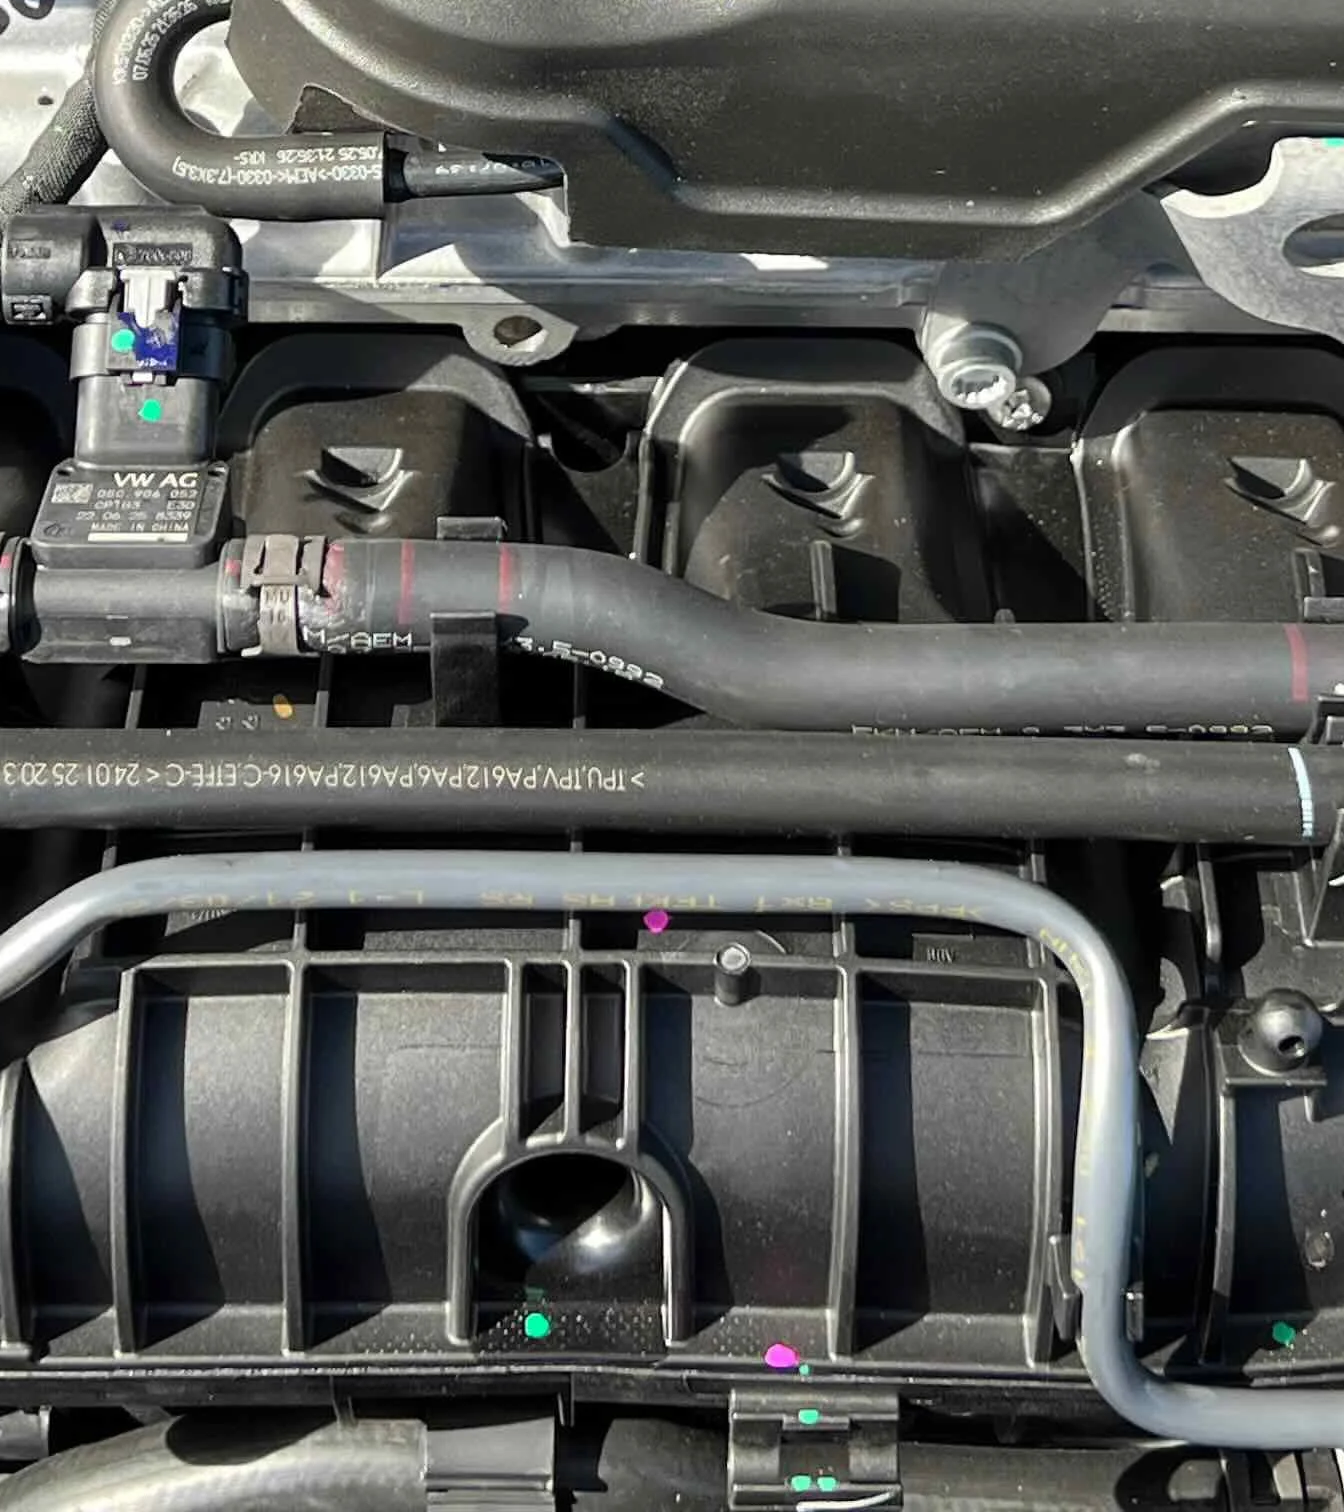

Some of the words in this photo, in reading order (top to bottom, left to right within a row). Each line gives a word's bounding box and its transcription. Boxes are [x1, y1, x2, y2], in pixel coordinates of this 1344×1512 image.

[113, 472, 156, 488] VW
[159, 472, 198, 488] AG
[152, 522, 189, 531] CHINA
